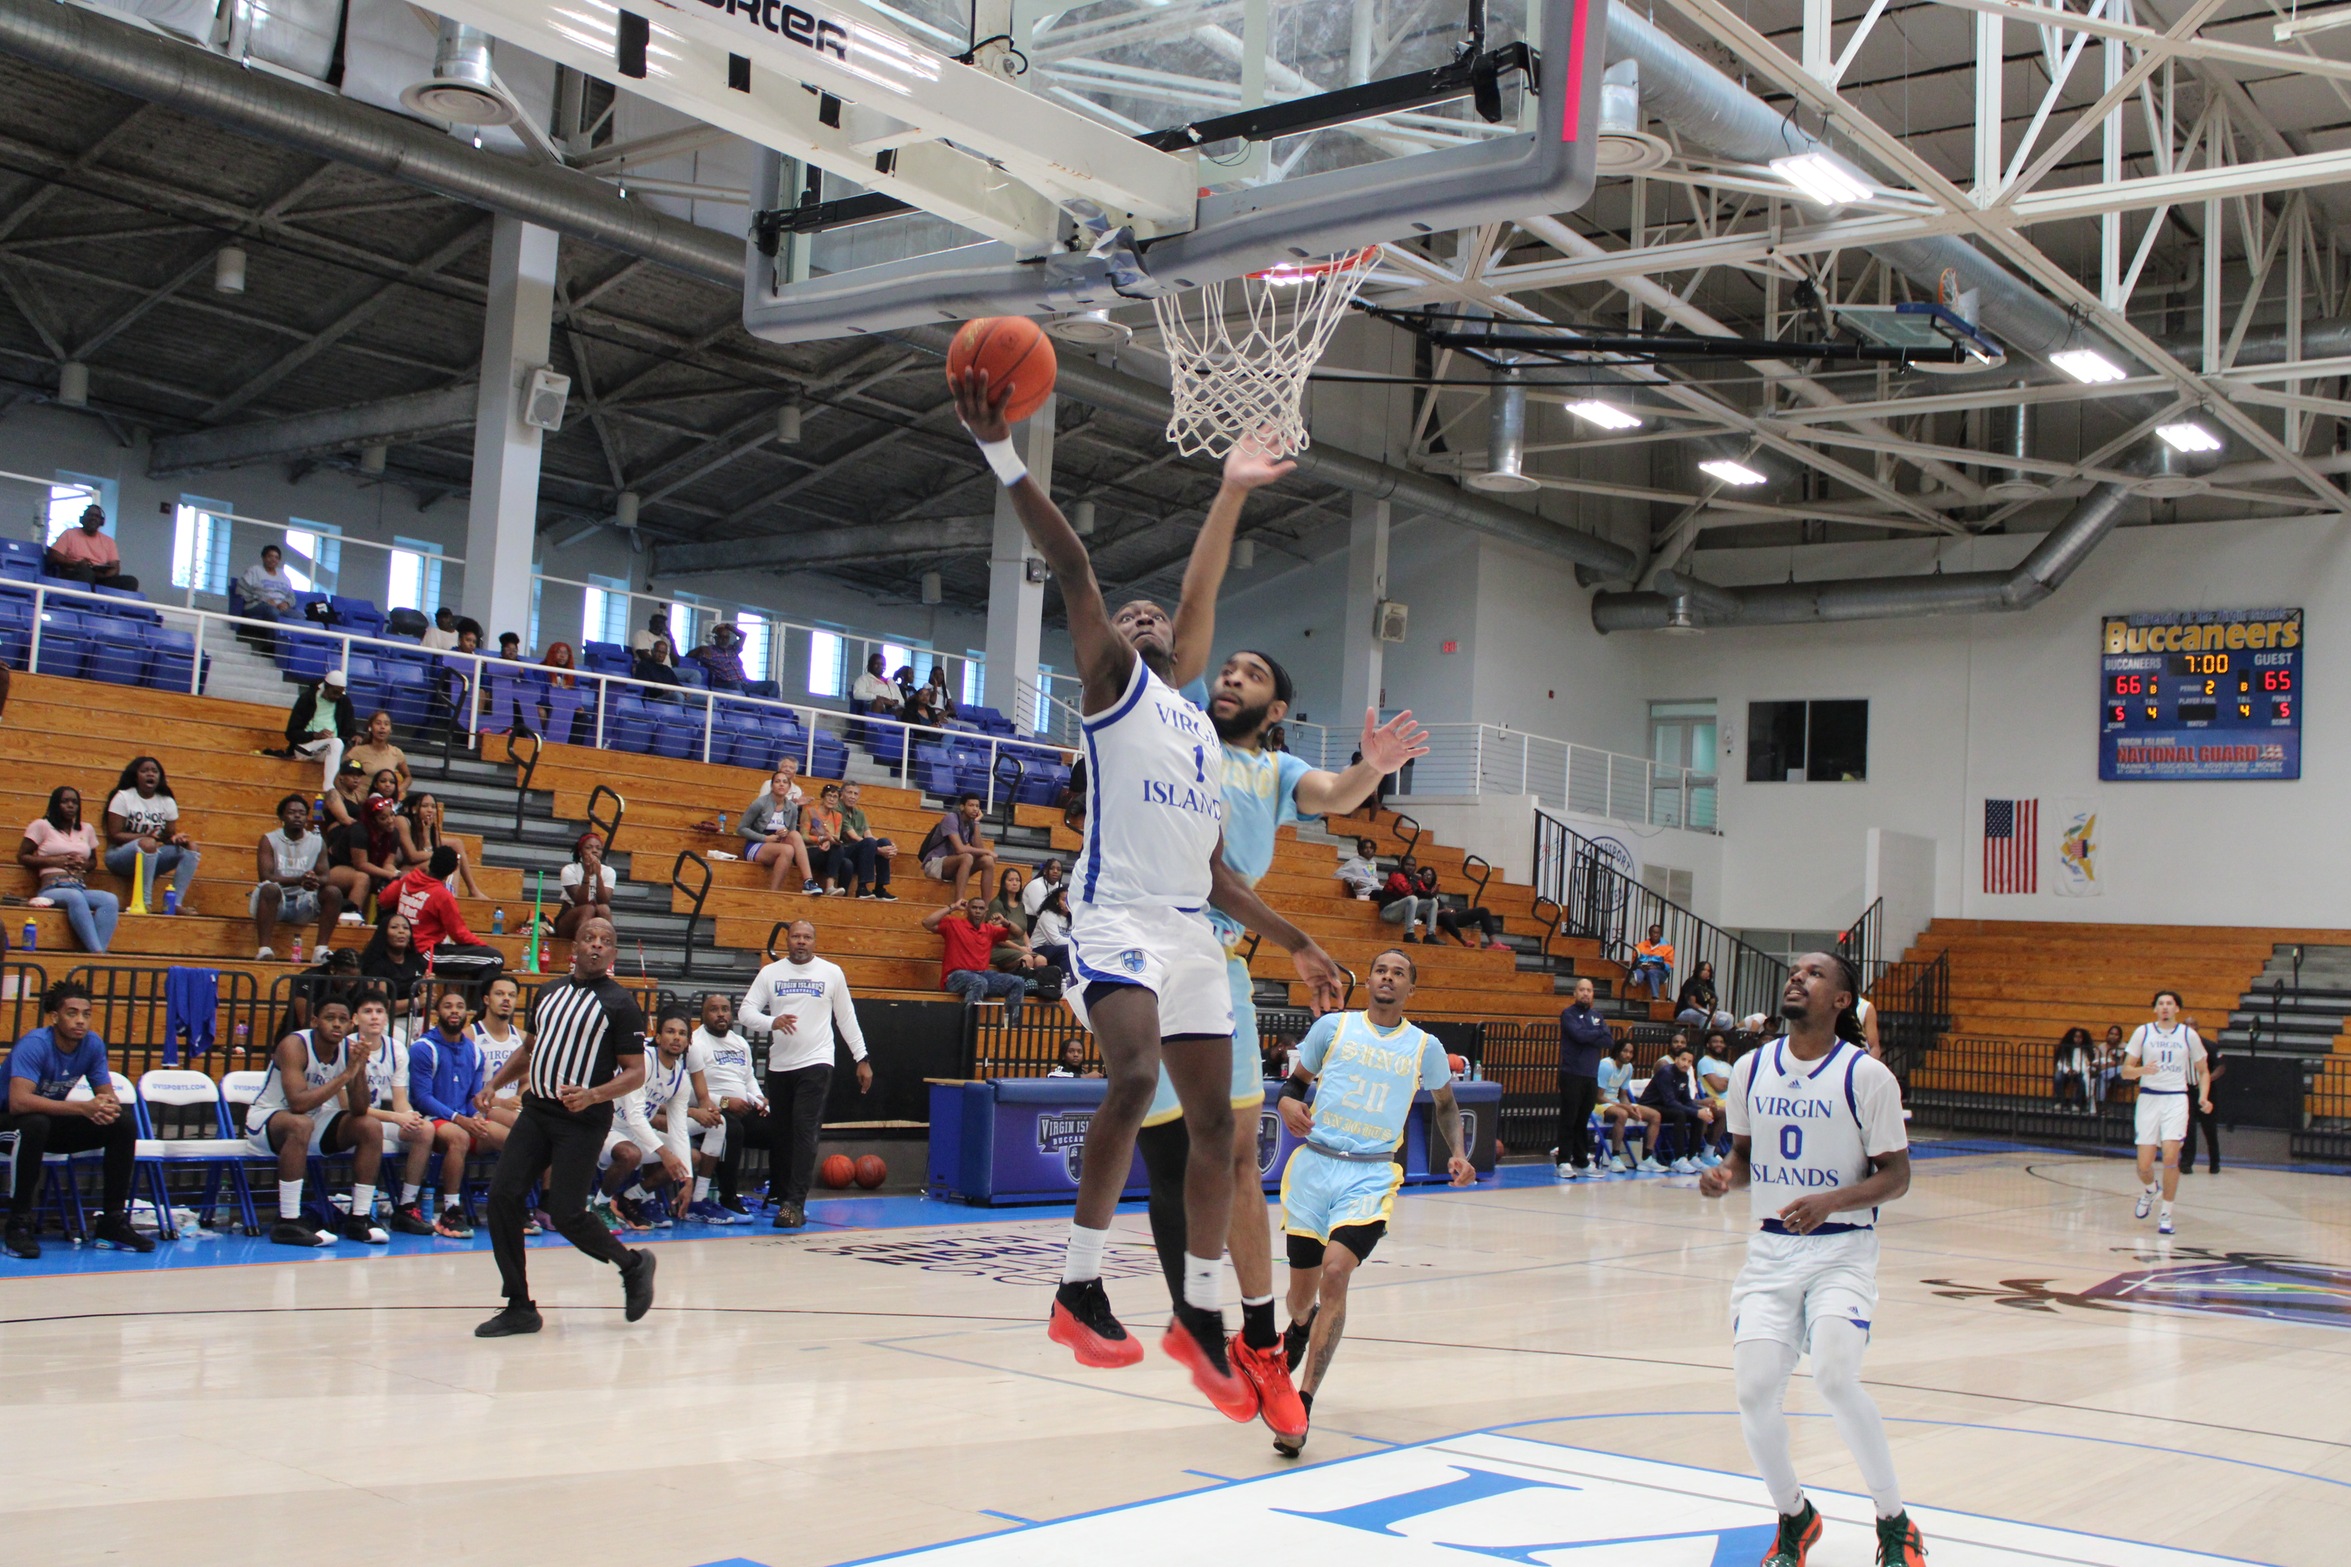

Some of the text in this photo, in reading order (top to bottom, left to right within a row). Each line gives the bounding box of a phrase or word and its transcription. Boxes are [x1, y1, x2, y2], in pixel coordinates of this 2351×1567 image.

[2104, 621, 2299, 654] Buccaneers
[2105, 657, 2162, 670] BUCCANEERS
[2185, 654, 2229, 674] 7:00
[2254, 652, 2293, 666] GUEST
[2116, 675, 2142, 695] 66
[2205, 680, 2216, 695] 2
[2264, 670, 2292, 691] 65
[2115, 706, 2125, 721] 5
[2147, 707, 2157, 719] 4
[2239, 704, 2250, 717] 4
[2279, 702, 2290, 718] 5
[2117, 744, 2259, 763] NATIONAL GUARD
[1193, 744, 1205, 783] 1
[776, 981, 824, 993] VIRGIN ISLANDS
[2161, 1050, 2173, 1063] 11
[152, 1083, 207, 1091] UVISPORTS.COM
[1341, 1074, 1391, 1114] 20
[1755, 1095, 1833, 1119] VIRGIN
[1042, 1119, 1075, 1140] VIRGIN
[1780, 1124, 1803, 1160] 0
[1750, 1162, 1840, 1187] SLANDS
[803, 1235, 1041, 1257] ISLANDS
